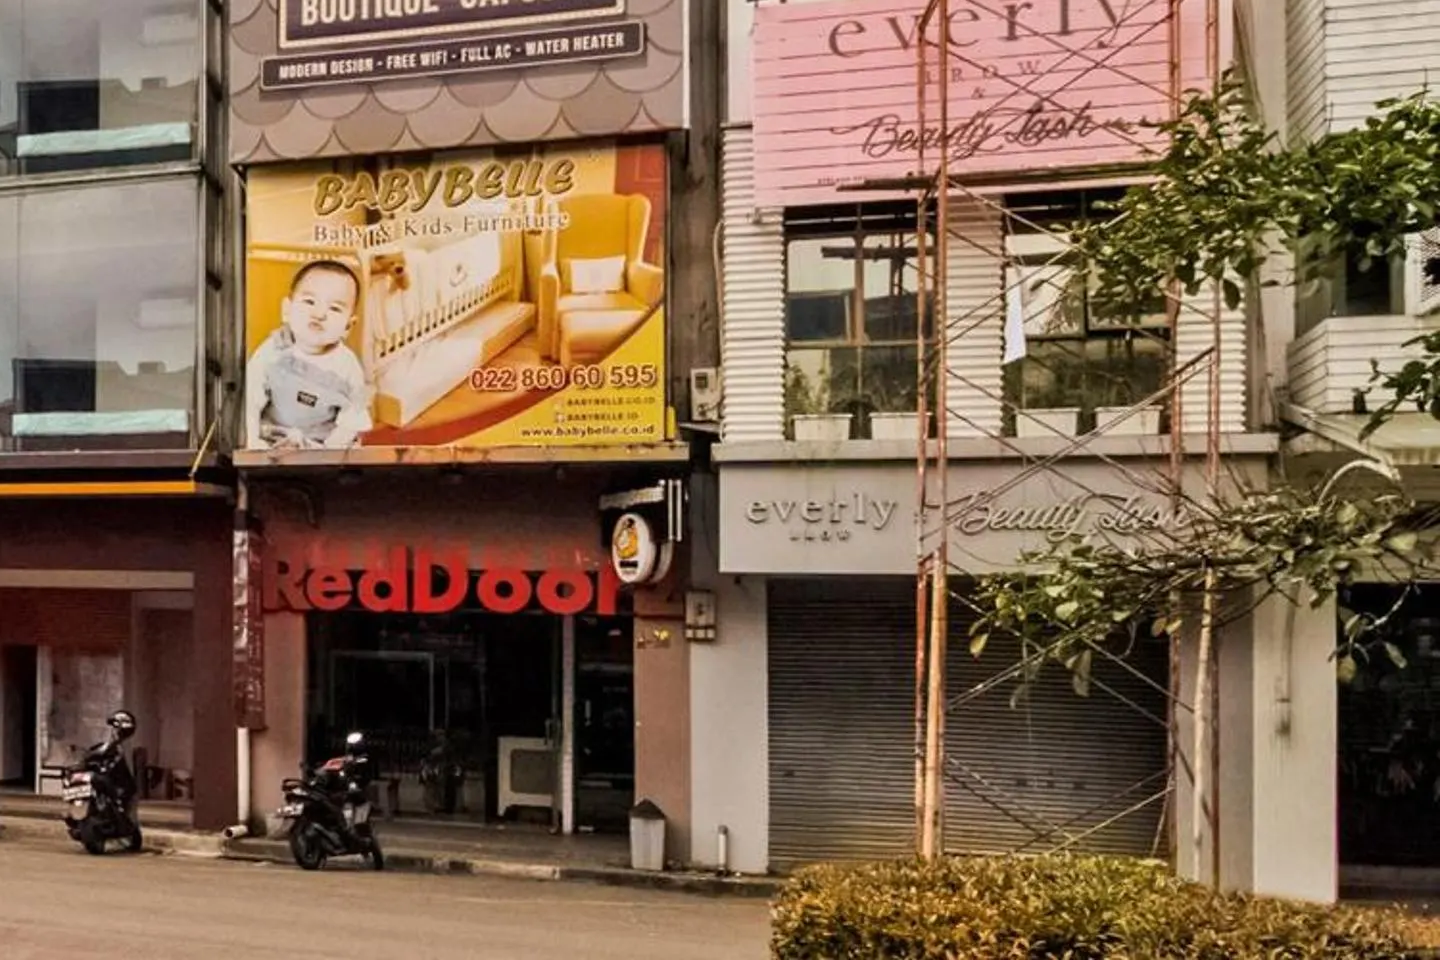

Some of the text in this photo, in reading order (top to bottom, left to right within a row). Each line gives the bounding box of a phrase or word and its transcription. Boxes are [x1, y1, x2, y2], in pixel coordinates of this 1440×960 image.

[279, 61, 327, 79] MODERN
[330, 58, 373, 75] DESIGN
[387, 54, 416, 69] FREE
[420, 50, 448, 66] WIFI
[461, 47, 491, 63] FULL
[494, 43, 511, 59] AC
[525, 38, 569, 56] WATER
[573, 32, 625, 51] HEATER
[845, 101, 1095, 157] Beauty Lash
[314, 159, 575, 216] BABYBELLE
[314, 222, 363, 243] Baby
[403, 216, 453, 237] Kids
[463, 210, 570, 234] Furniture
[471, 365, 656, 389] 022 860 60 595
[745, 492, 899, 530] everly
[956, 491, 1082, 543] Beauty
